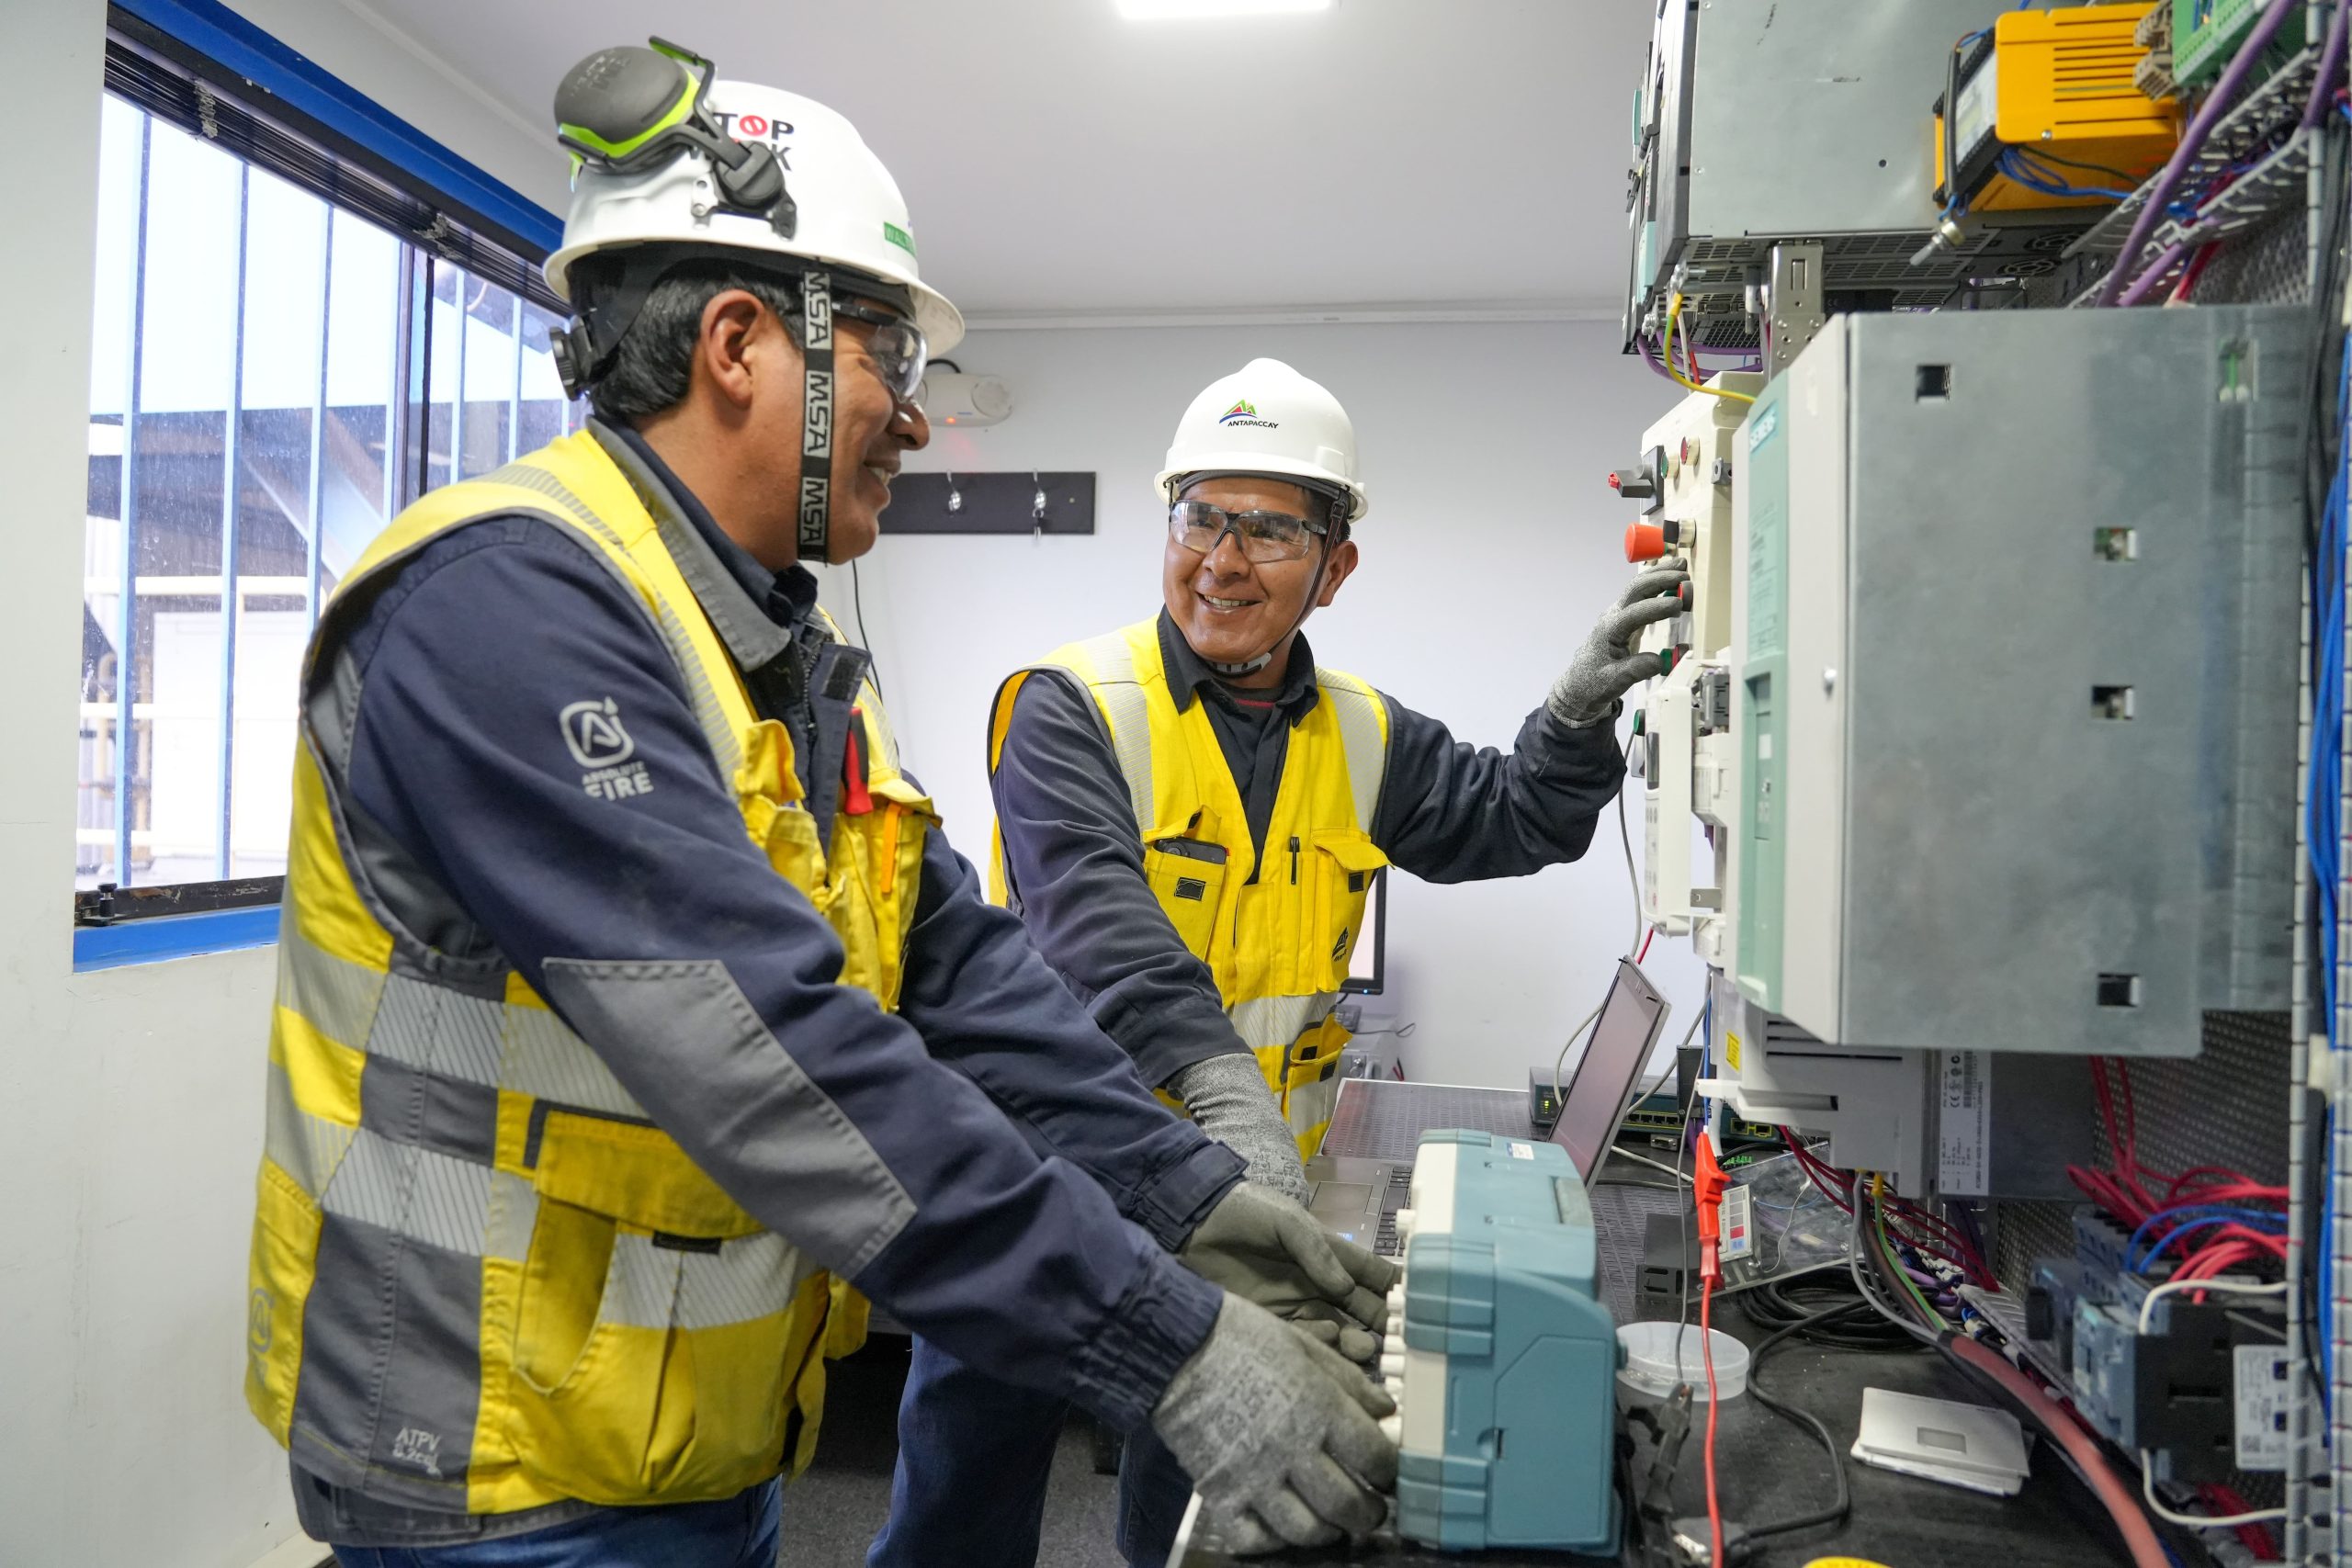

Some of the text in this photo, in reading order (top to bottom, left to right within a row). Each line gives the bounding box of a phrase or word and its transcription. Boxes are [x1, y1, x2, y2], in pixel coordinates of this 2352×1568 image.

[713, 112, 794, 141] TOP
[808, 272, 830, 345] MSA
[808, 373, 830, 453] MSA
[1227, 420, 1279, 429] ANTAPACCAY
[803, 479, 825, 544] MSA
[584, 772, 654, 801] FIRE
[395, 1427, 441, 1451] ATPV
